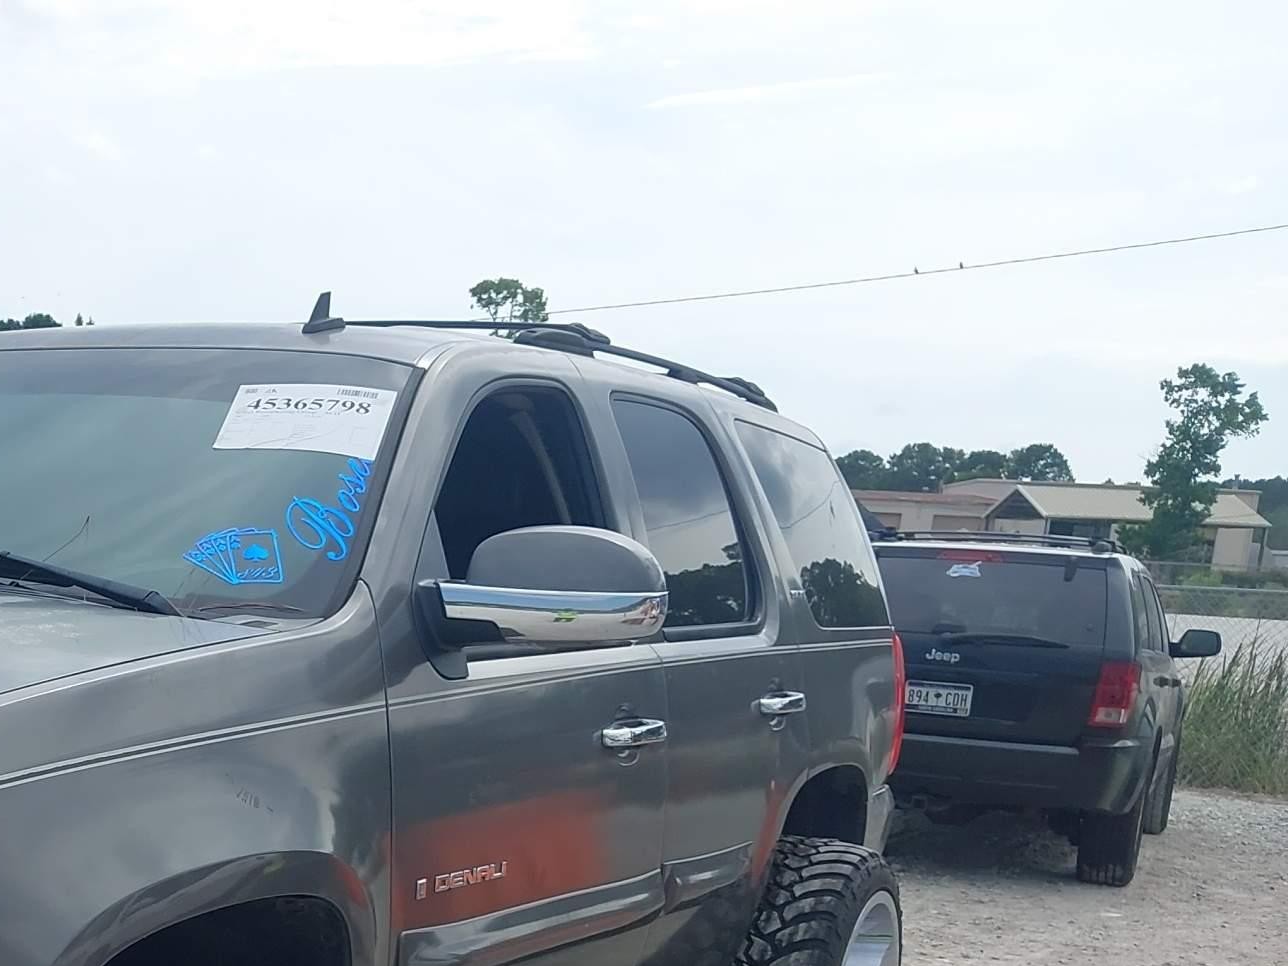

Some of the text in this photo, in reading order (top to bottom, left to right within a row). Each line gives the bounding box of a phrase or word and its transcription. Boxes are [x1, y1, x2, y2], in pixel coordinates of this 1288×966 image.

[247, 398, 373, 415] 45365798
[925, 648, 960, 664] Jeep
[908, 689, 968, 707] 894 CDH
[434, 861, 508, 893] DENALI
